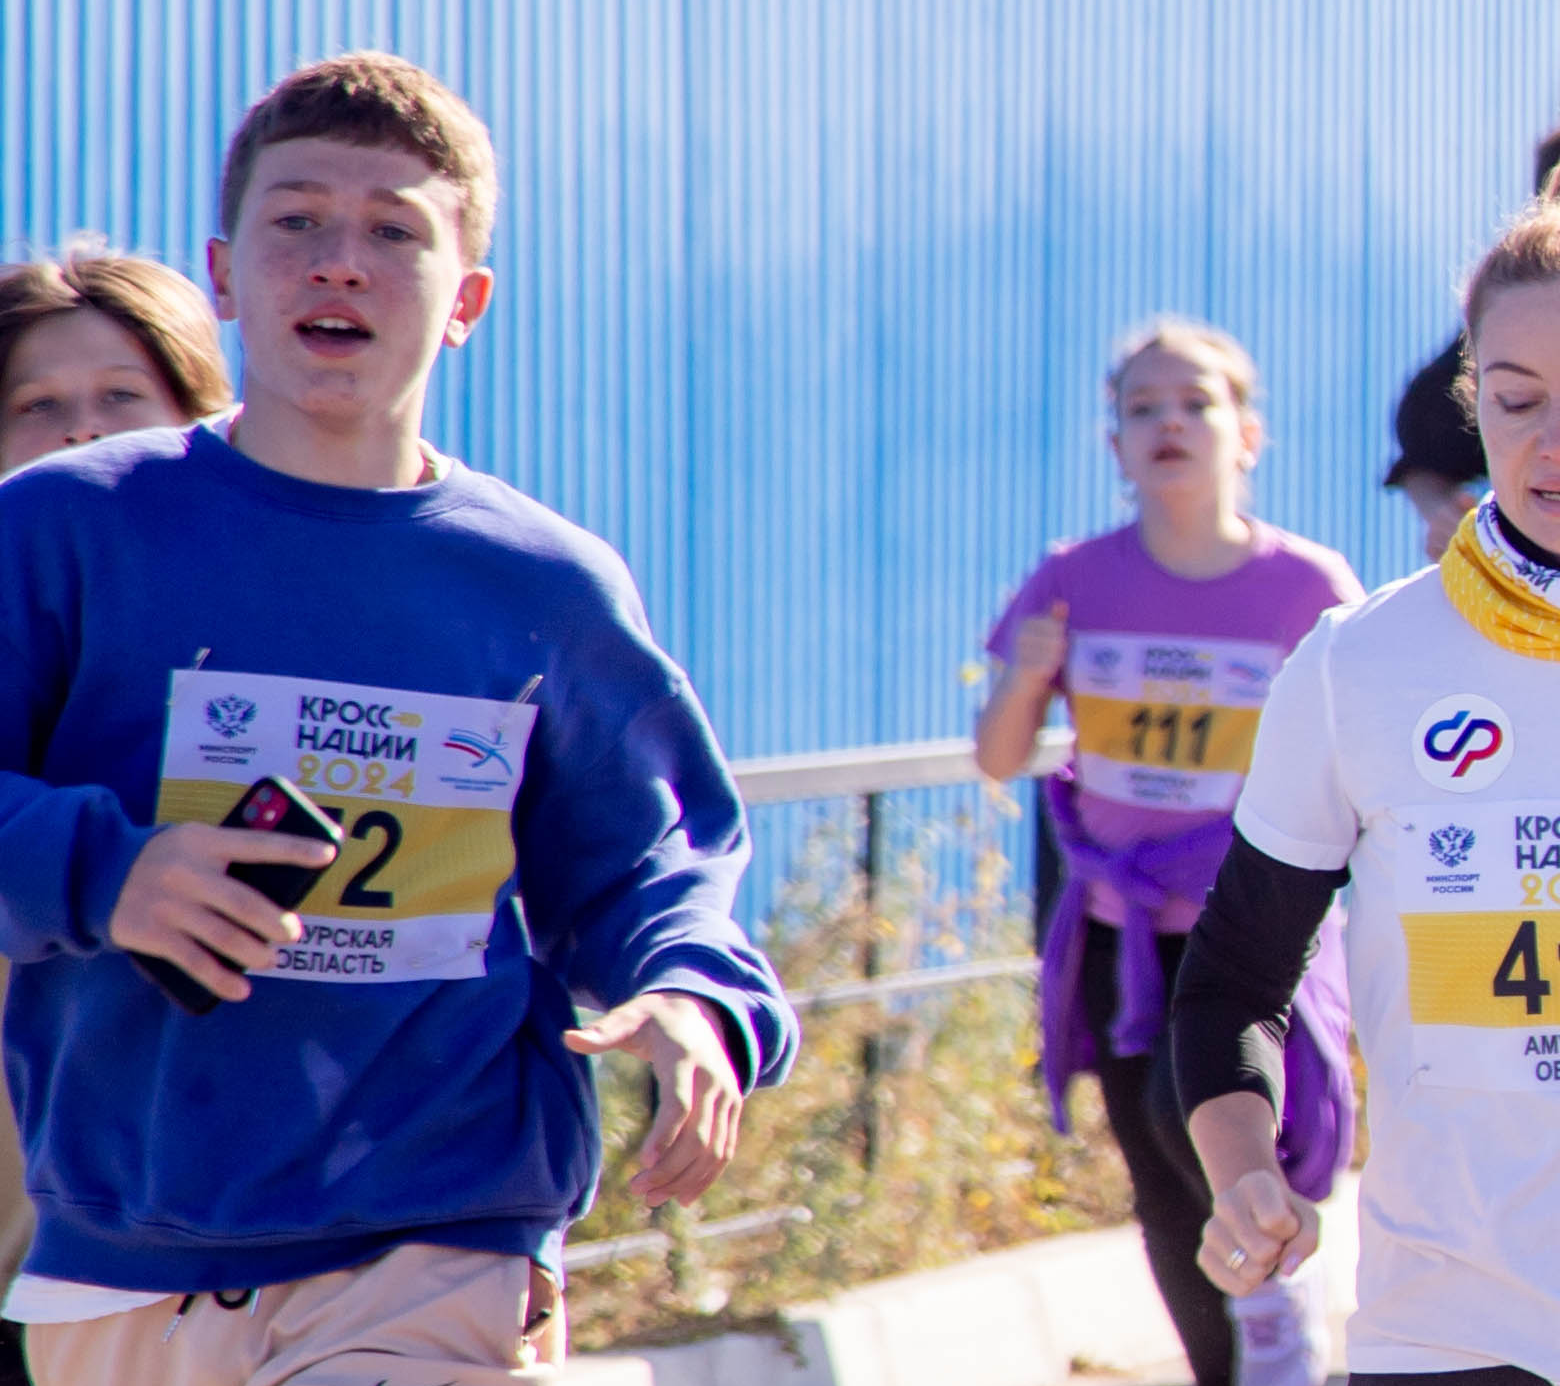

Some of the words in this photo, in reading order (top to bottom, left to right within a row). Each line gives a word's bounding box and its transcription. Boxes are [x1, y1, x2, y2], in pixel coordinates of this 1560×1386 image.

[300, 695, 392, 729] КРОСС
[297, 724, 417, 763] НАЦИИ
[1131, 705, 1214, 766] 111
[296, 754, 415, 798] 2024
[316, 806, 403, 909] 2
[299, 924, 395, 949] УРСКАЯ
